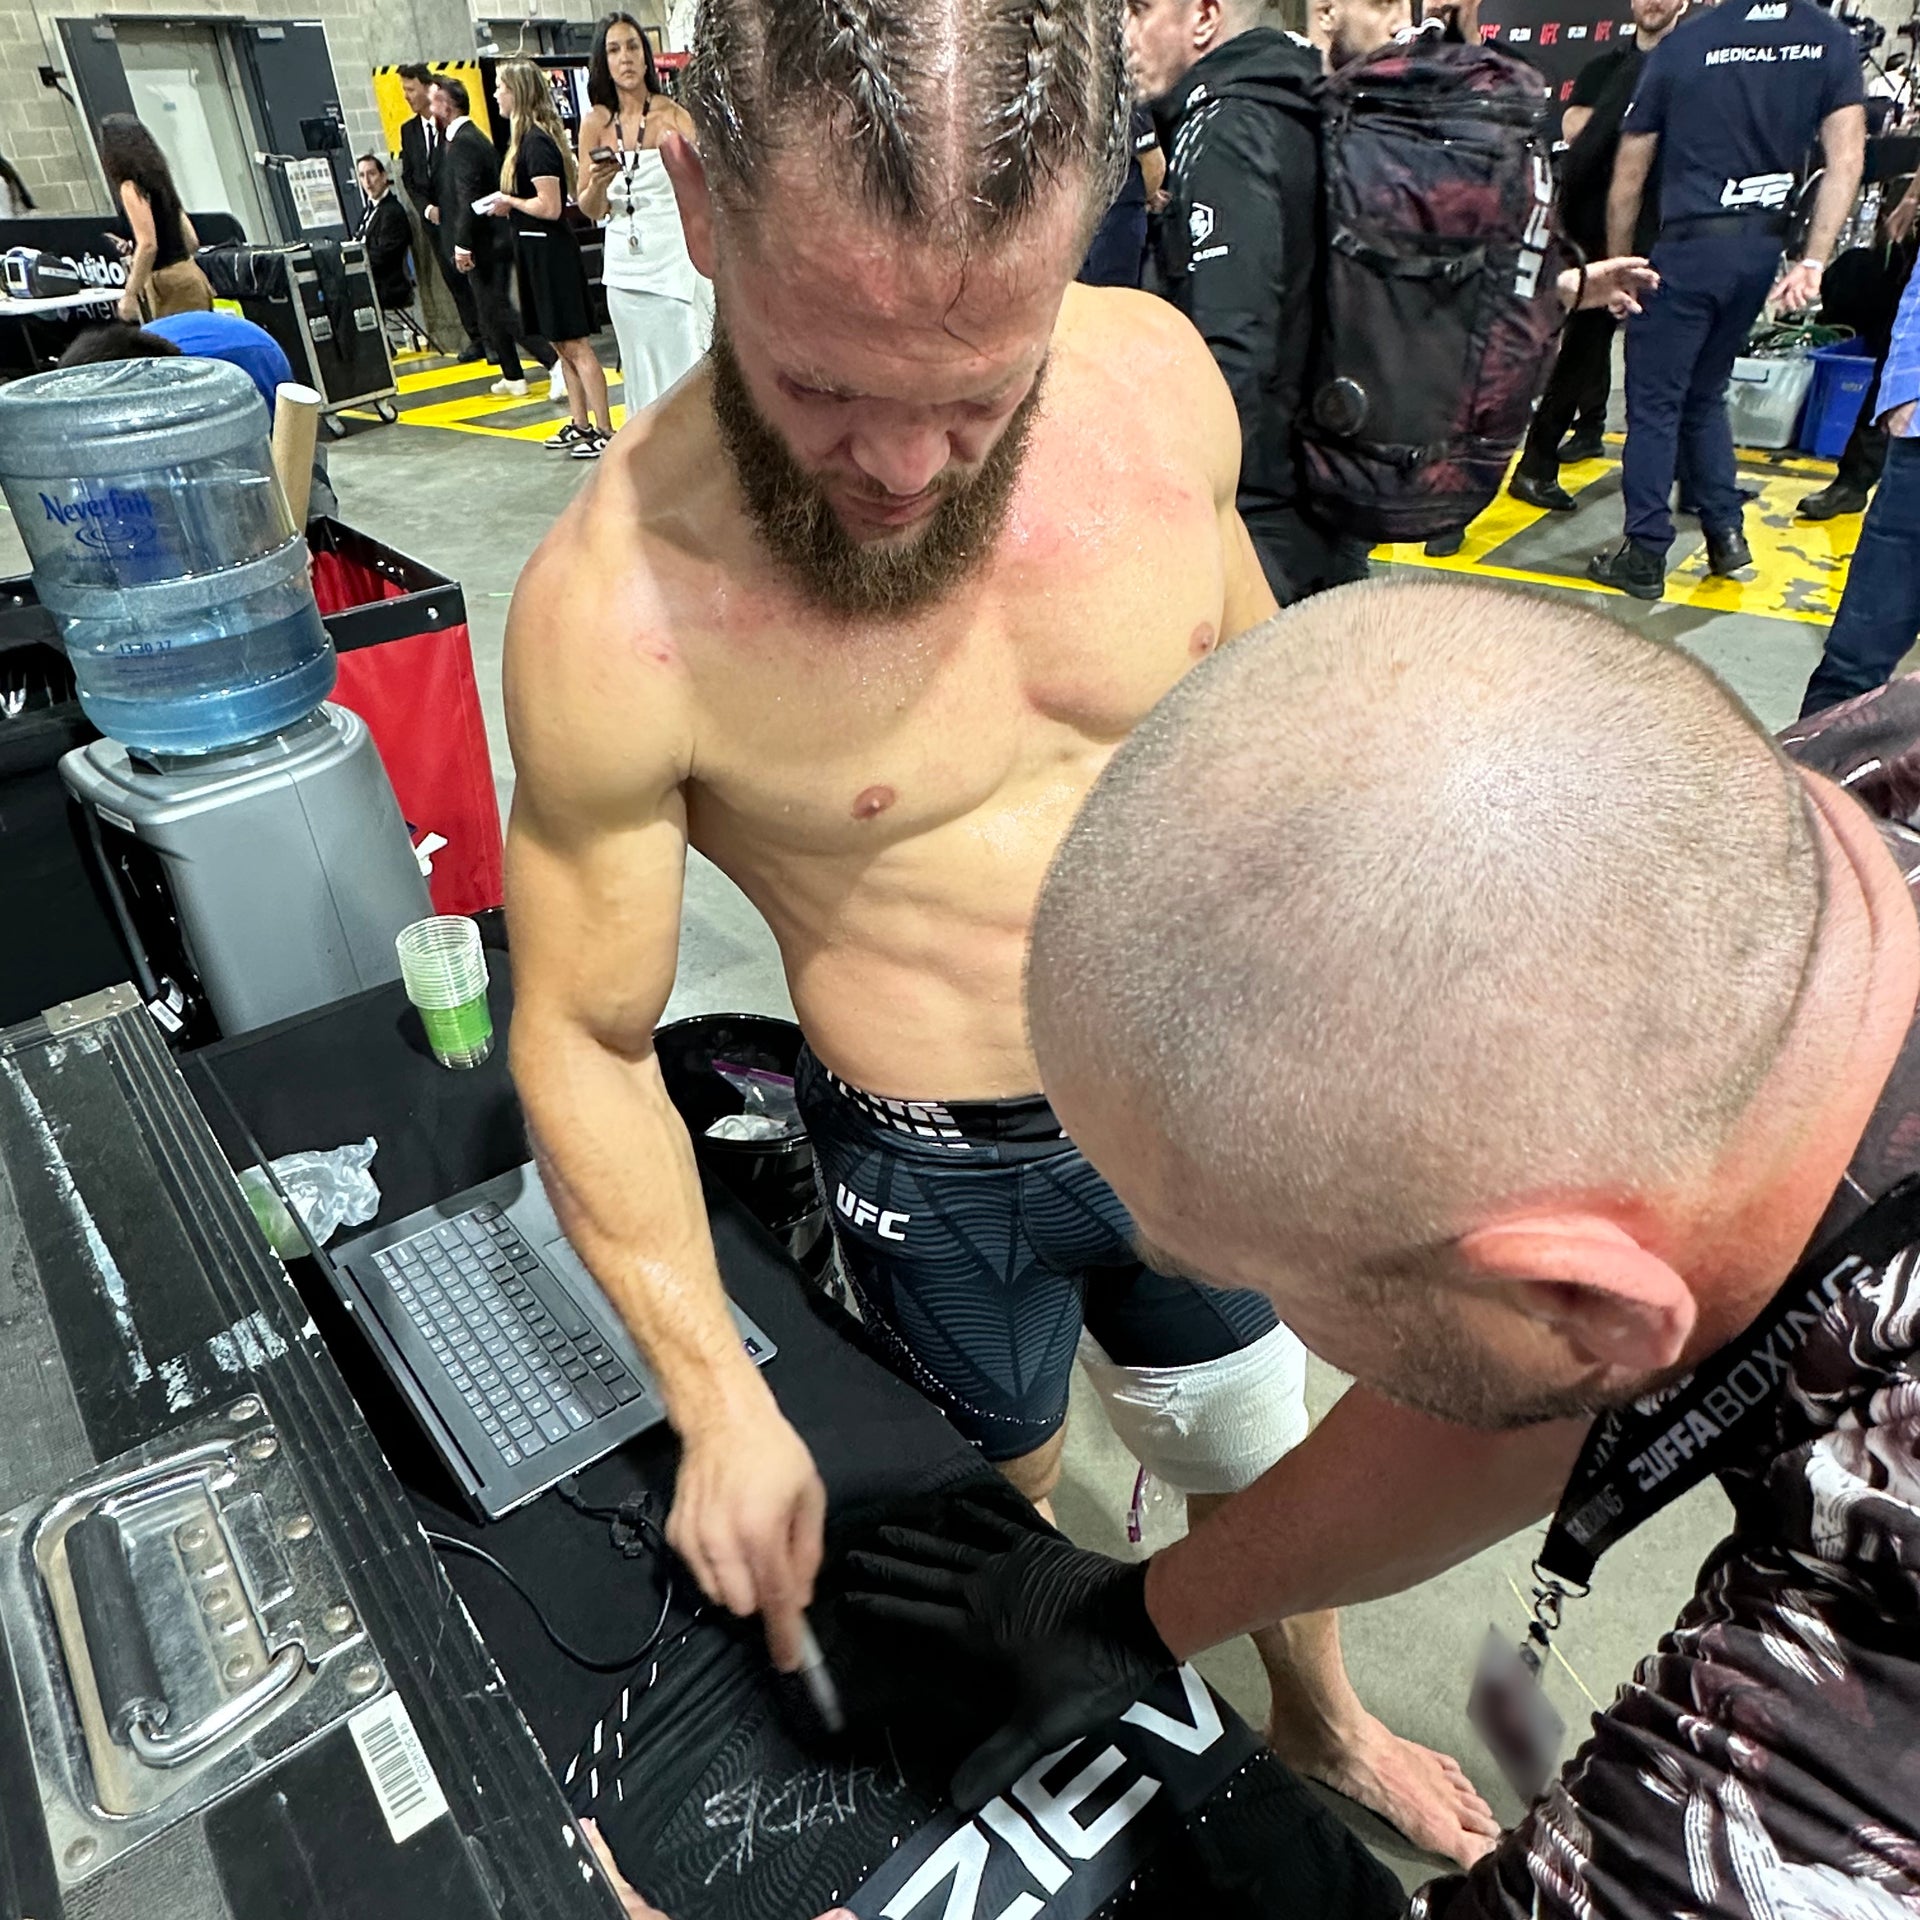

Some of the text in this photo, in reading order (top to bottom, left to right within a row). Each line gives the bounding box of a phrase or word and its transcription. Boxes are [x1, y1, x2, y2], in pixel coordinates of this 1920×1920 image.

[1745, 3, 1787, 20] AMS
[1705, 44, 1822, 66] MEDICAL TEAM
[38, 488, 153, 526] Neverfail
[836, 1177, 910, 1241] UFC
